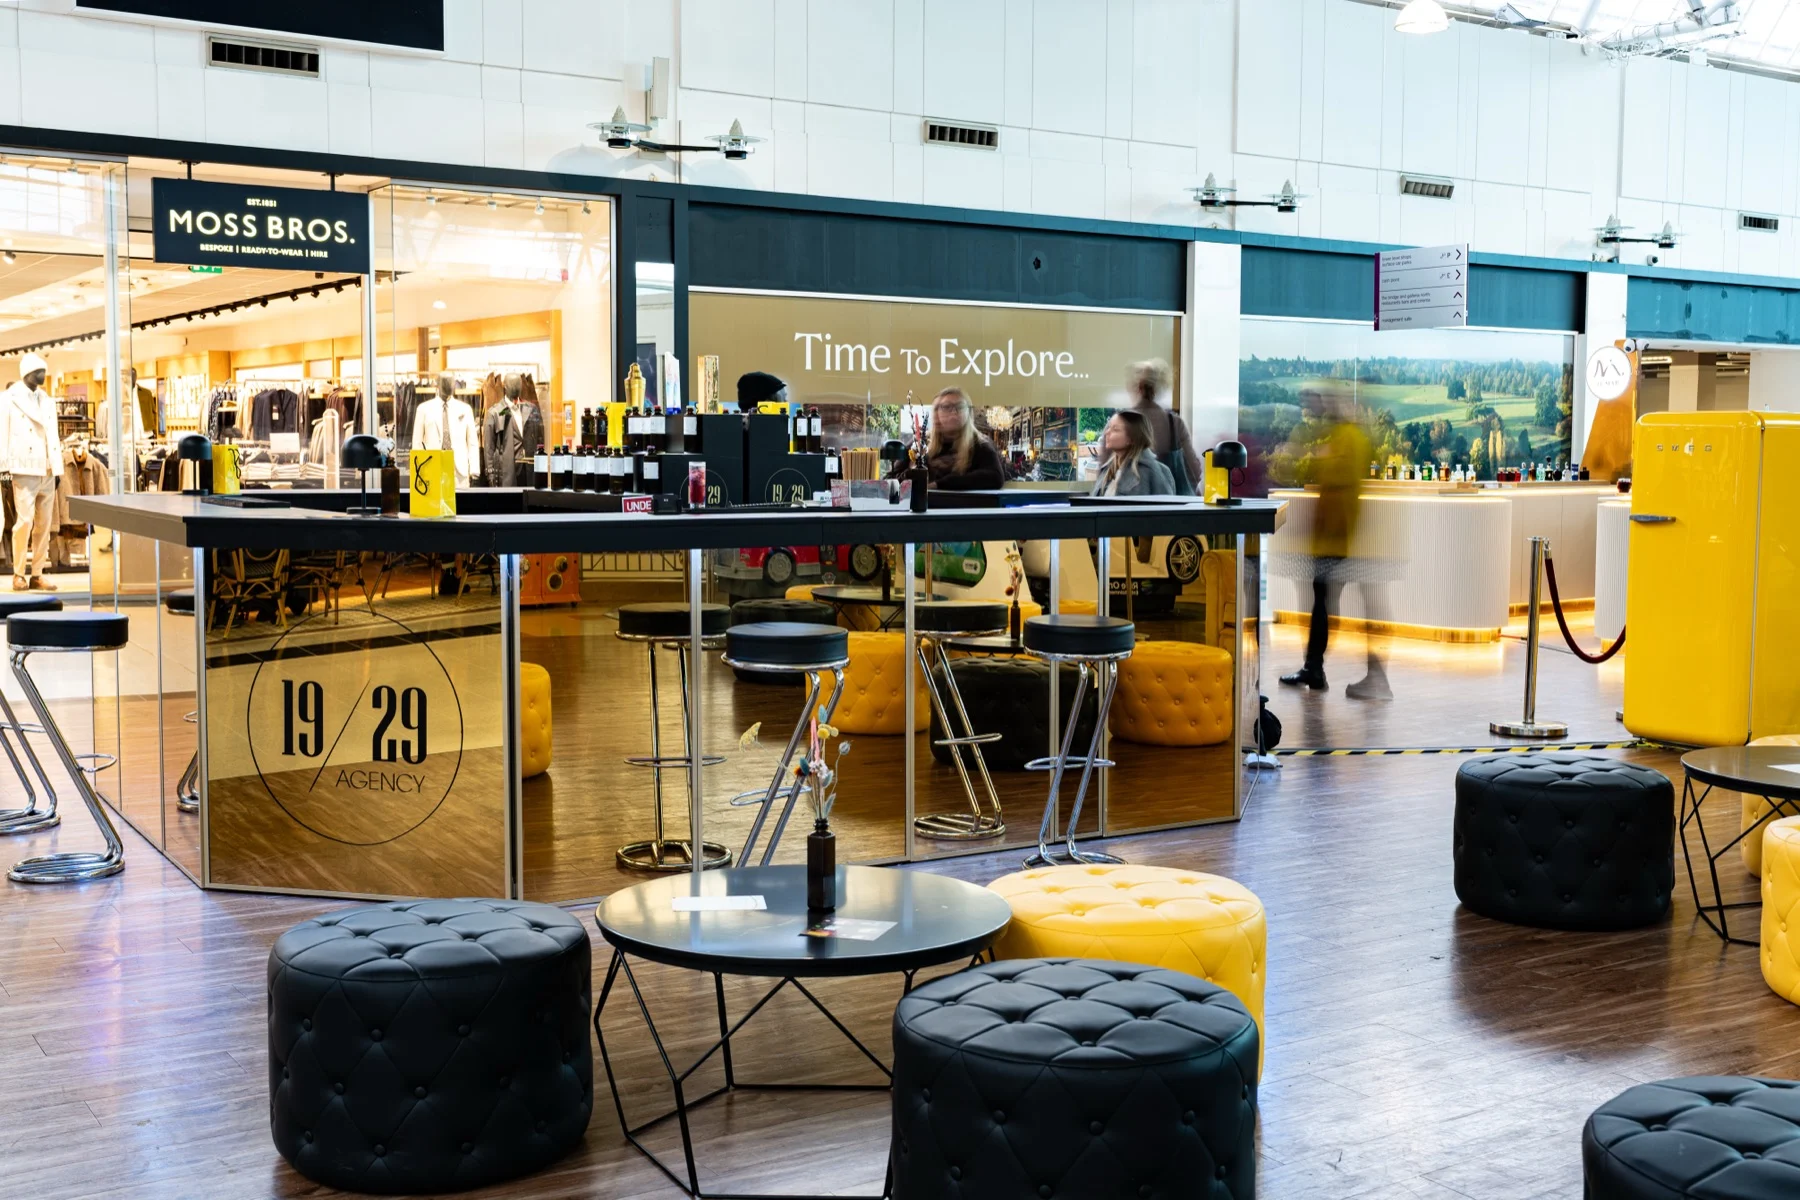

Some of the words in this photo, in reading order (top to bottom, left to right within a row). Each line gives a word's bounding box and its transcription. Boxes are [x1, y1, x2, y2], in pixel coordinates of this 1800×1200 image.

[168, 209, 257, 238] MOSS
[267, 216, 356, 244] BROS.
[200, 243, 234, 253] BESPOKE
[241, 246, 304, 257] READY-TO-WEAR
[310, 250, 328, 258] HIRE
[794, 332, 891, 373] Time
[900, 348, 931, 375] To
[940, 337, 1089, 387] Explore...
[1656, 443, 1712, 452] SMEG
[0, 457, 52, 469] WINTE
[626, 500, 652, 511] UNDE
[335, 770, 426, 793] AGENCY
